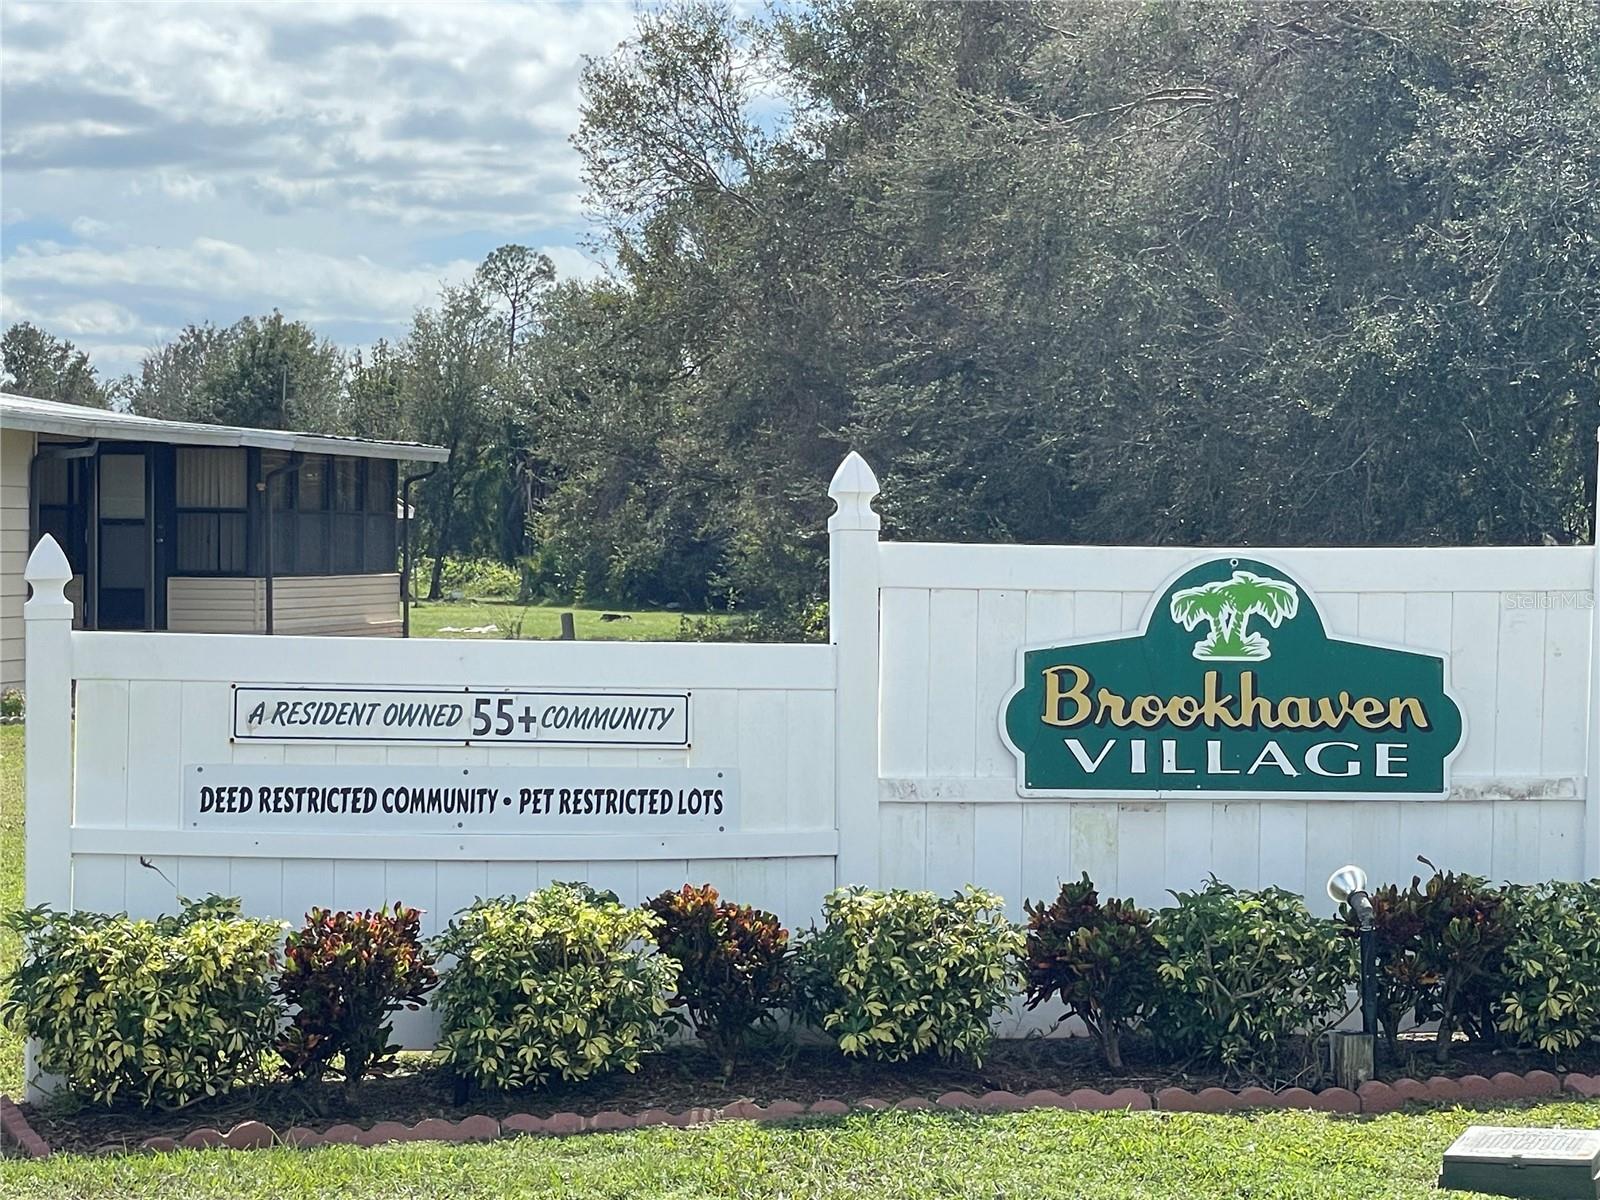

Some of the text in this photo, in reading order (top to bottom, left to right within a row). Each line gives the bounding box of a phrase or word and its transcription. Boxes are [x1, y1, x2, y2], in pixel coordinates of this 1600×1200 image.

[248, 698, 675, 736] A RESIDENT OWNED 55+ COMMUNITY
[1041, 664, 1432, 732] Brookhaven
[1064, 739, 1408, 778] VILLAGE
[200, 786, 723, 815] DEED RESTRICTED COMMUNITY PET RESTRICTED LOTS
